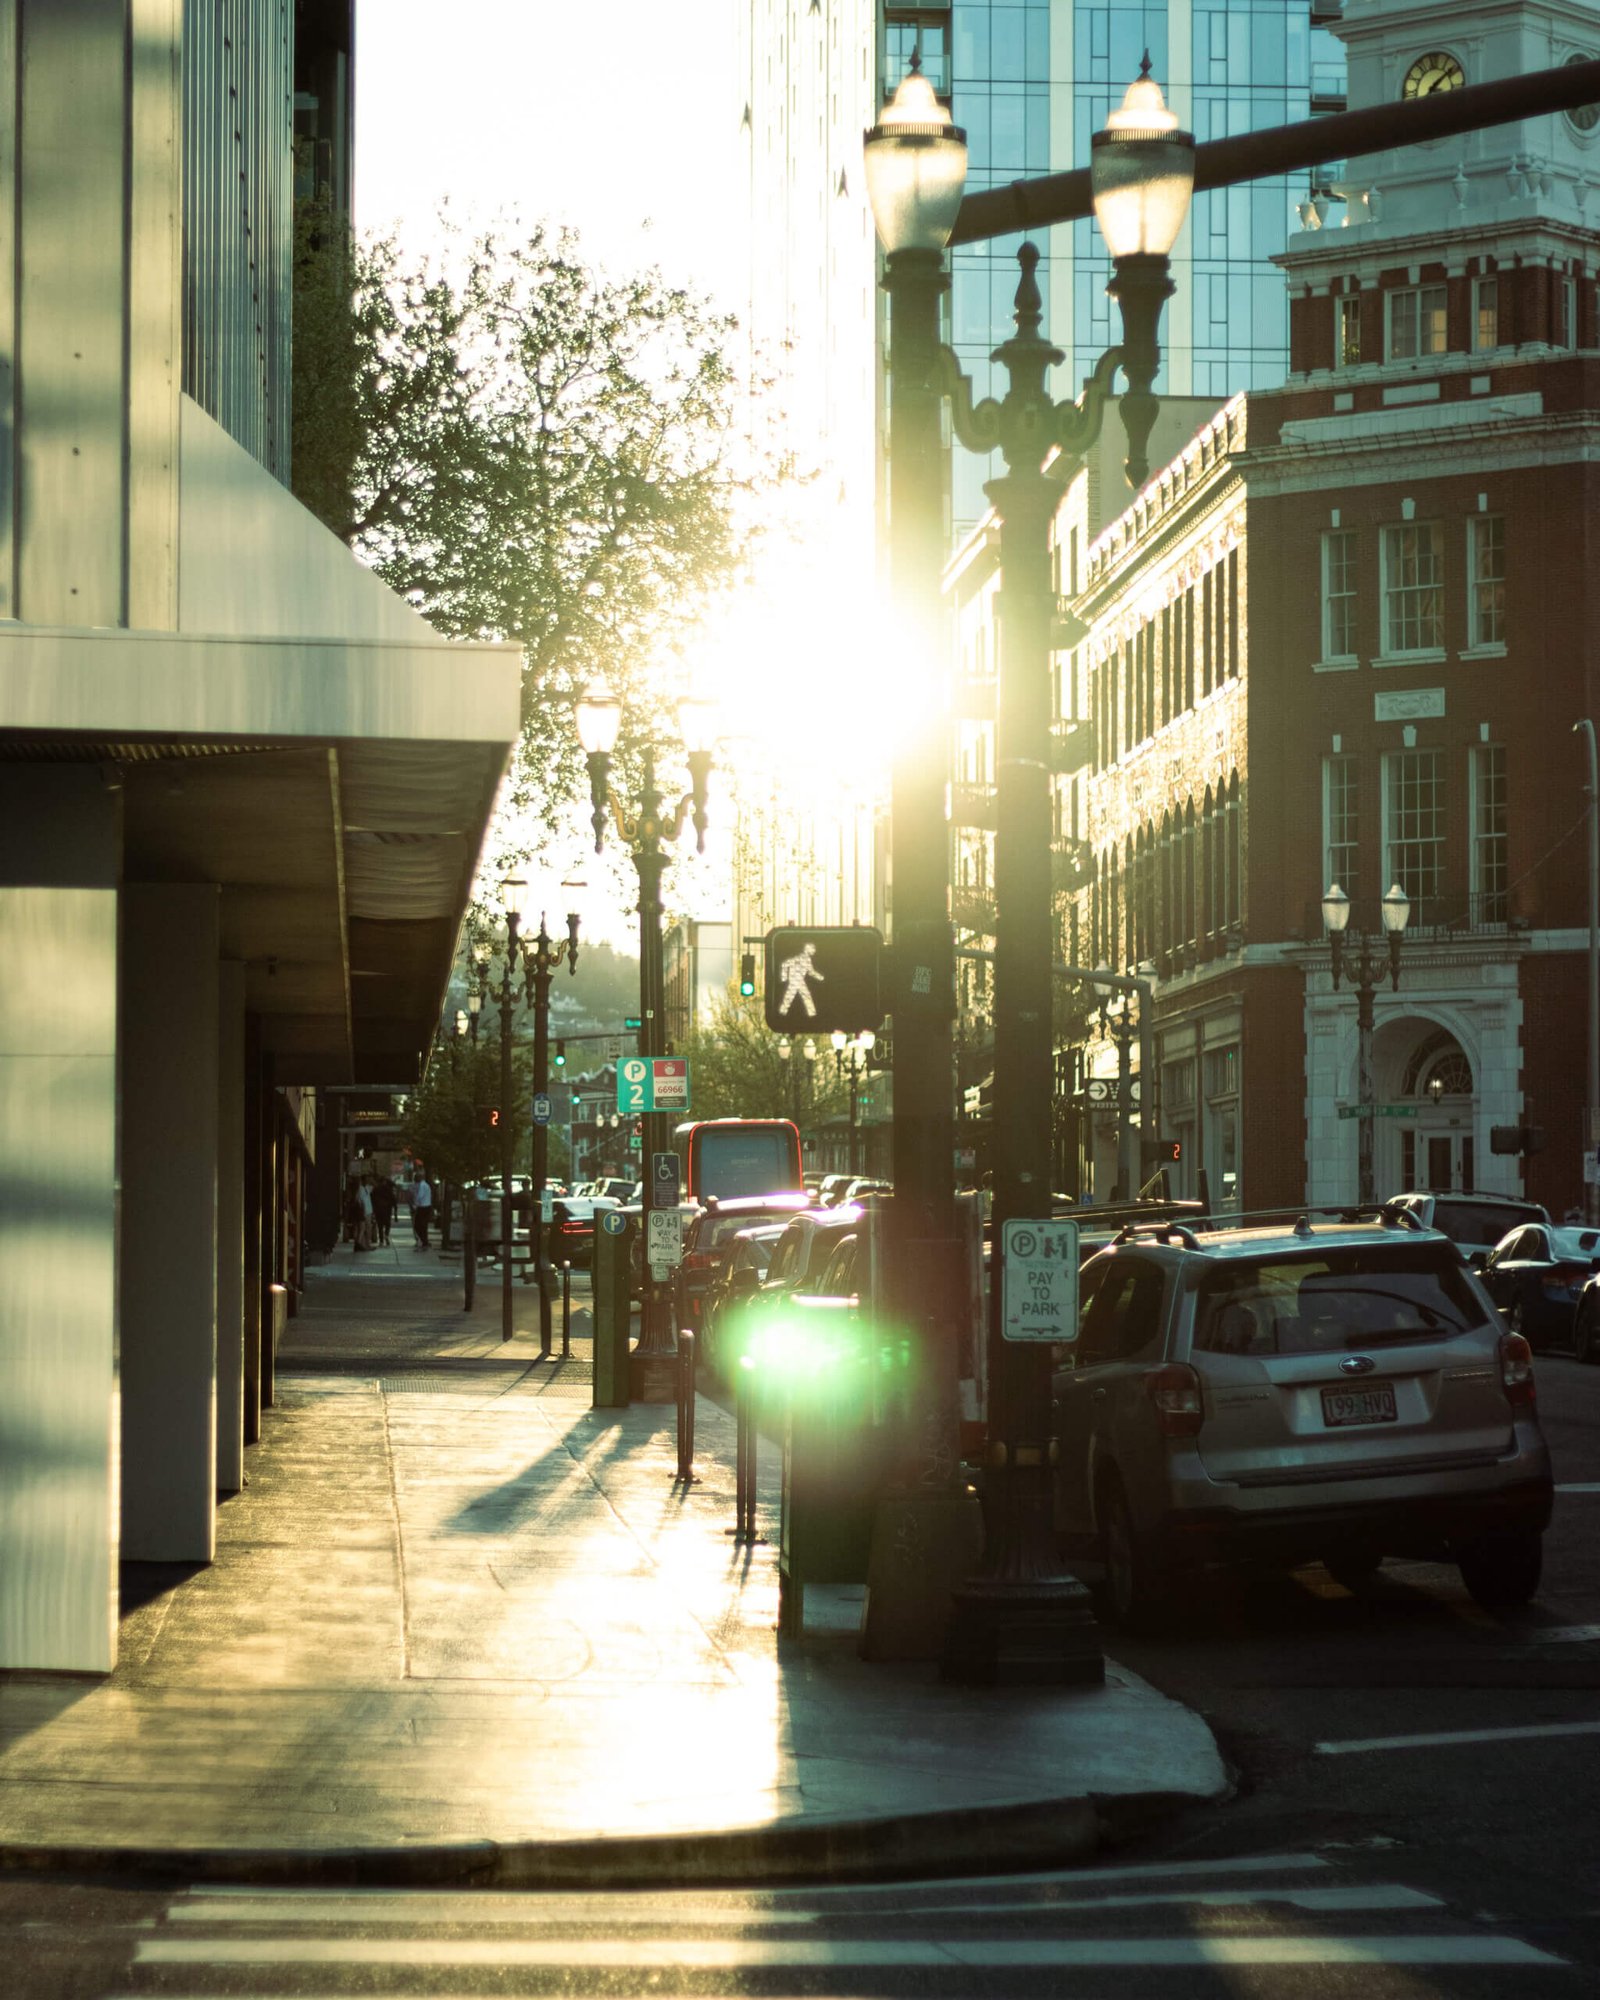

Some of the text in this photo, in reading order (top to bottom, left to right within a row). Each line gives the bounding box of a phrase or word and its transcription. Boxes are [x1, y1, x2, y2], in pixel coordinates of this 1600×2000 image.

[631, 1064, 641, 1079] P
[630, 1085, 644, 1104] 2
[492, 1110, 499, 1125] 2
[1173, 1143, 1181, 1159] 2
[610, 1215, 621, 1232] P
[1020, 1235, 1031, 1252] P
[1028, 1271, 1054, 1285] PAY
[1031, 1286, 1051, 1300] TO
[1021, 1302, 1061, 1316] PARK
